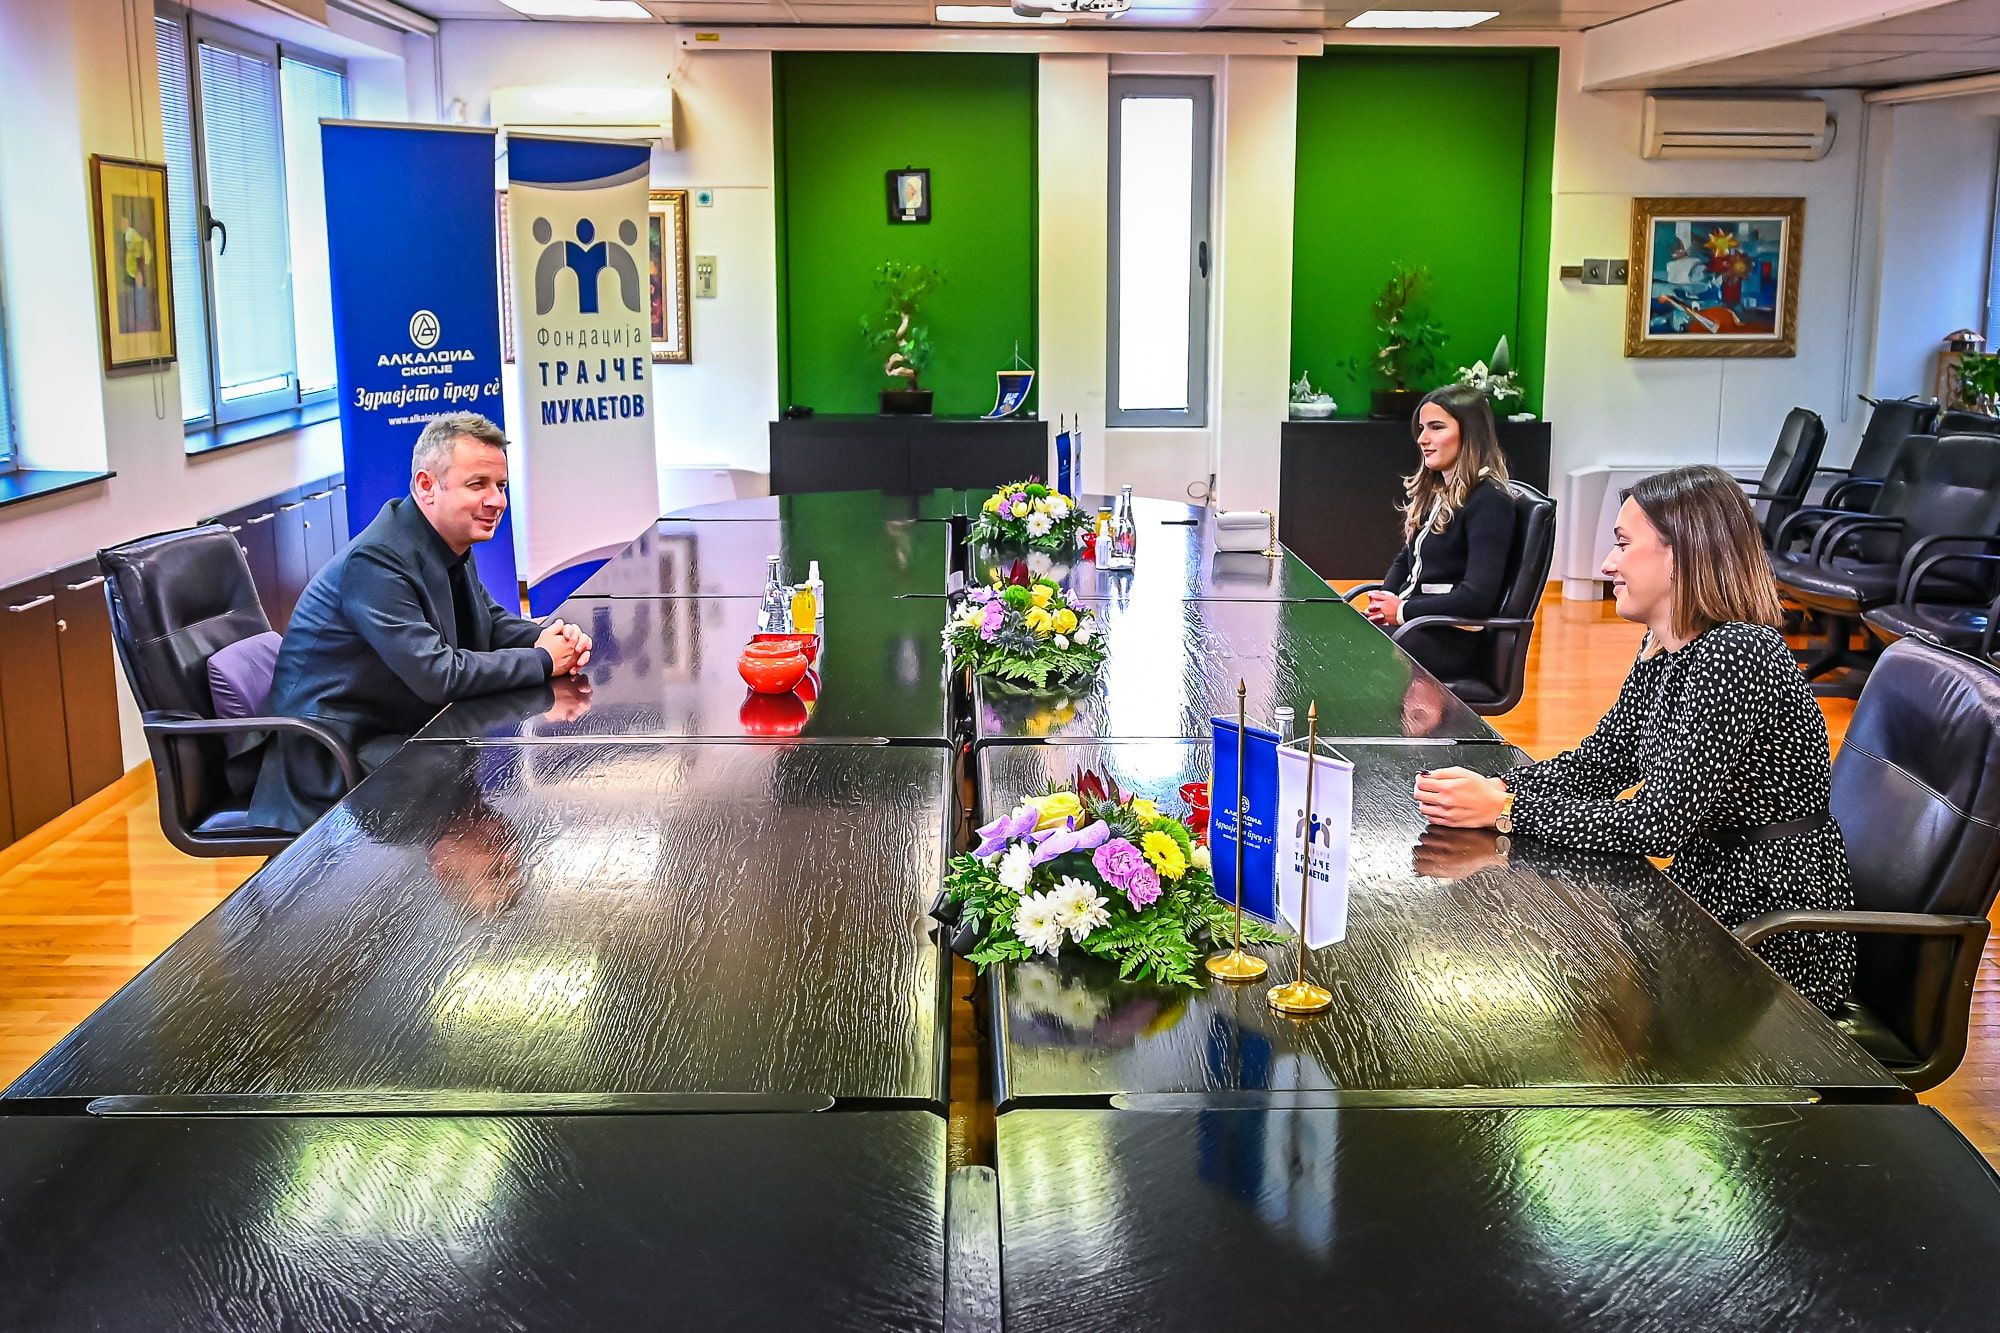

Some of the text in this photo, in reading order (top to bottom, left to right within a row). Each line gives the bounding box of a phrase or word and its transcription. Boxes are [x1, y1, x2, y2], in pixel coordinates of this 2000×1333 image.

[537, 323, 641, 348] Фондација
[377, 349, 476, 367] АЛКАЛОИД
[401, 364, 453, 377] СКОПЈЕ
[538, 357, 644, 387] ТРАЈЧЕ
[541, 394, 645, 425] МУКАЕТОВ
[1294, 863, 1330, 883] МУАЕТОВ
